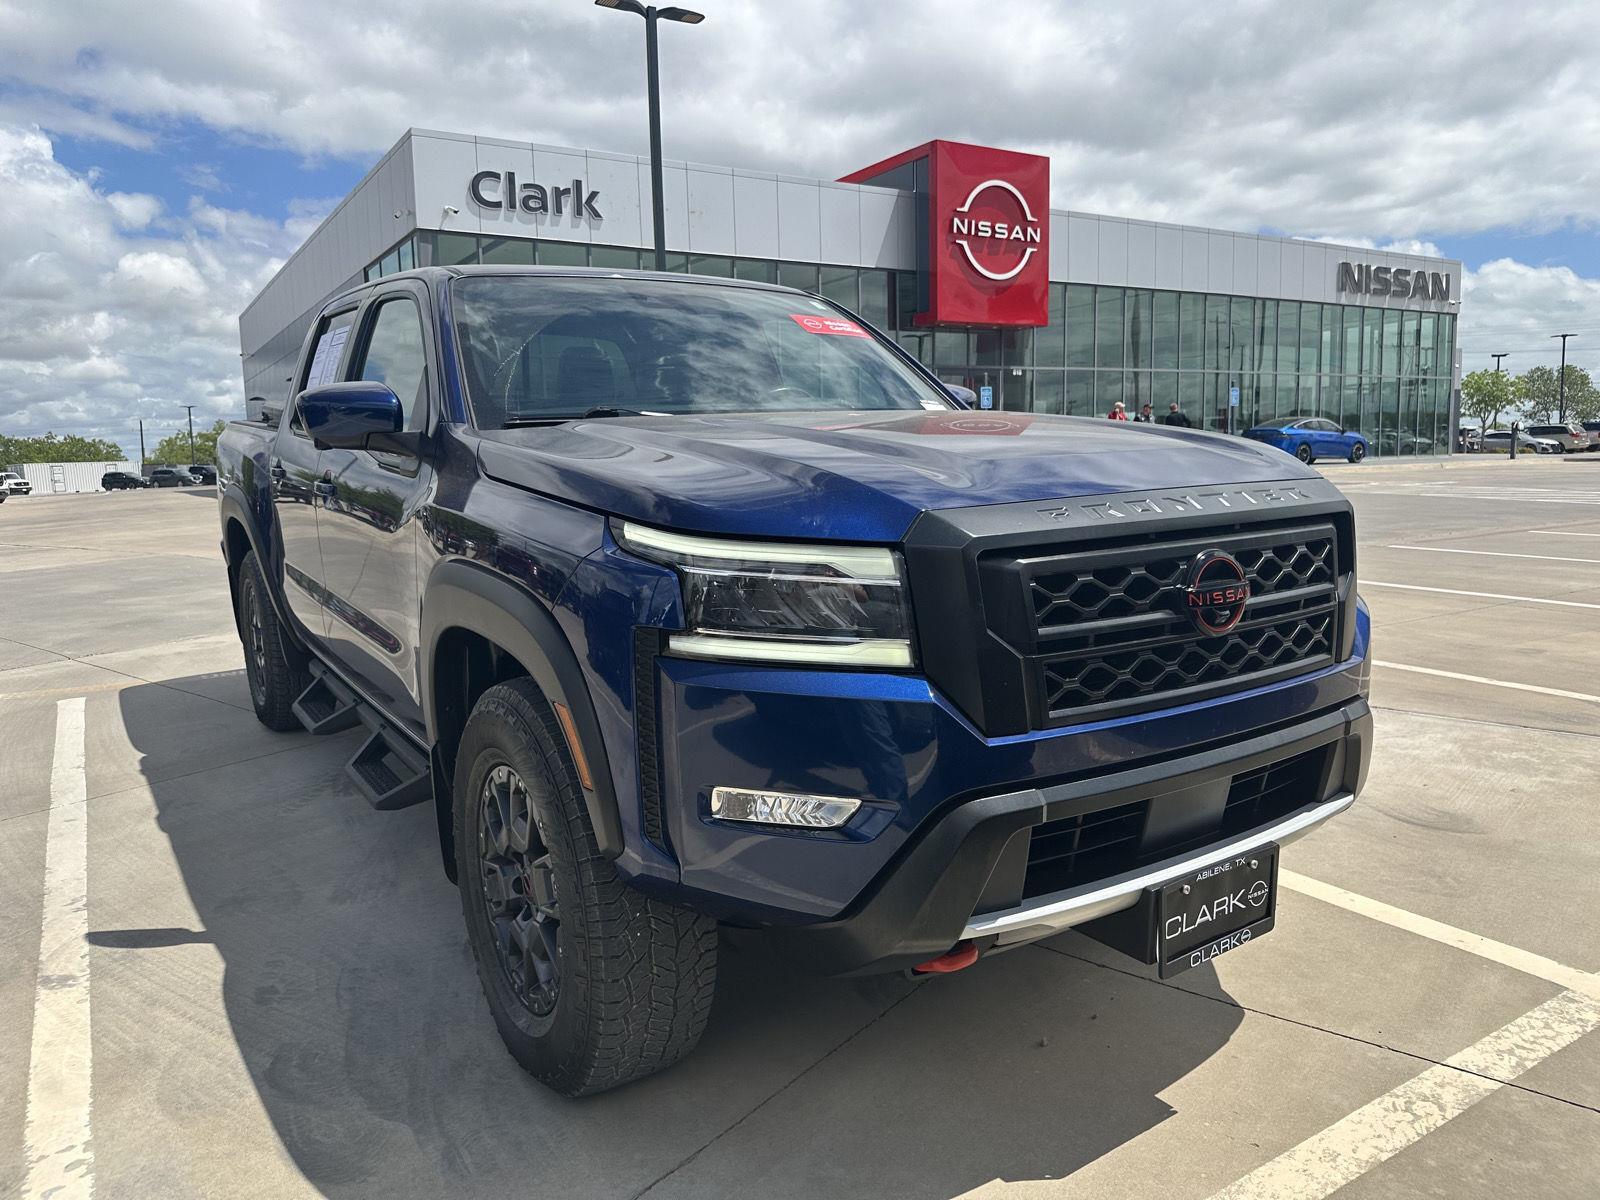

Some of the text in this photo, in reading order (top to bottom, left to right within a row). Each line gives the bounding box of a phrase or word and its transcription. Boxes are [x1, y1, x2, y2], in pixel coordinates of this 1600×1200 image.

[470, 170, 603, 219] Clark
[953, 217, 1041, 243] NISSAN
[1336, 261, 1450, 301] NISSAN
[1036, 487, 1311, 519] FRONTIER
[1196, 857, 1246, 882] ABILENE, TX
[1247, 887, 1269, 900] NISSAN
[1165, 889, 1246, 940] CLARK
[1190, 933, 1241, 968] CLARK
